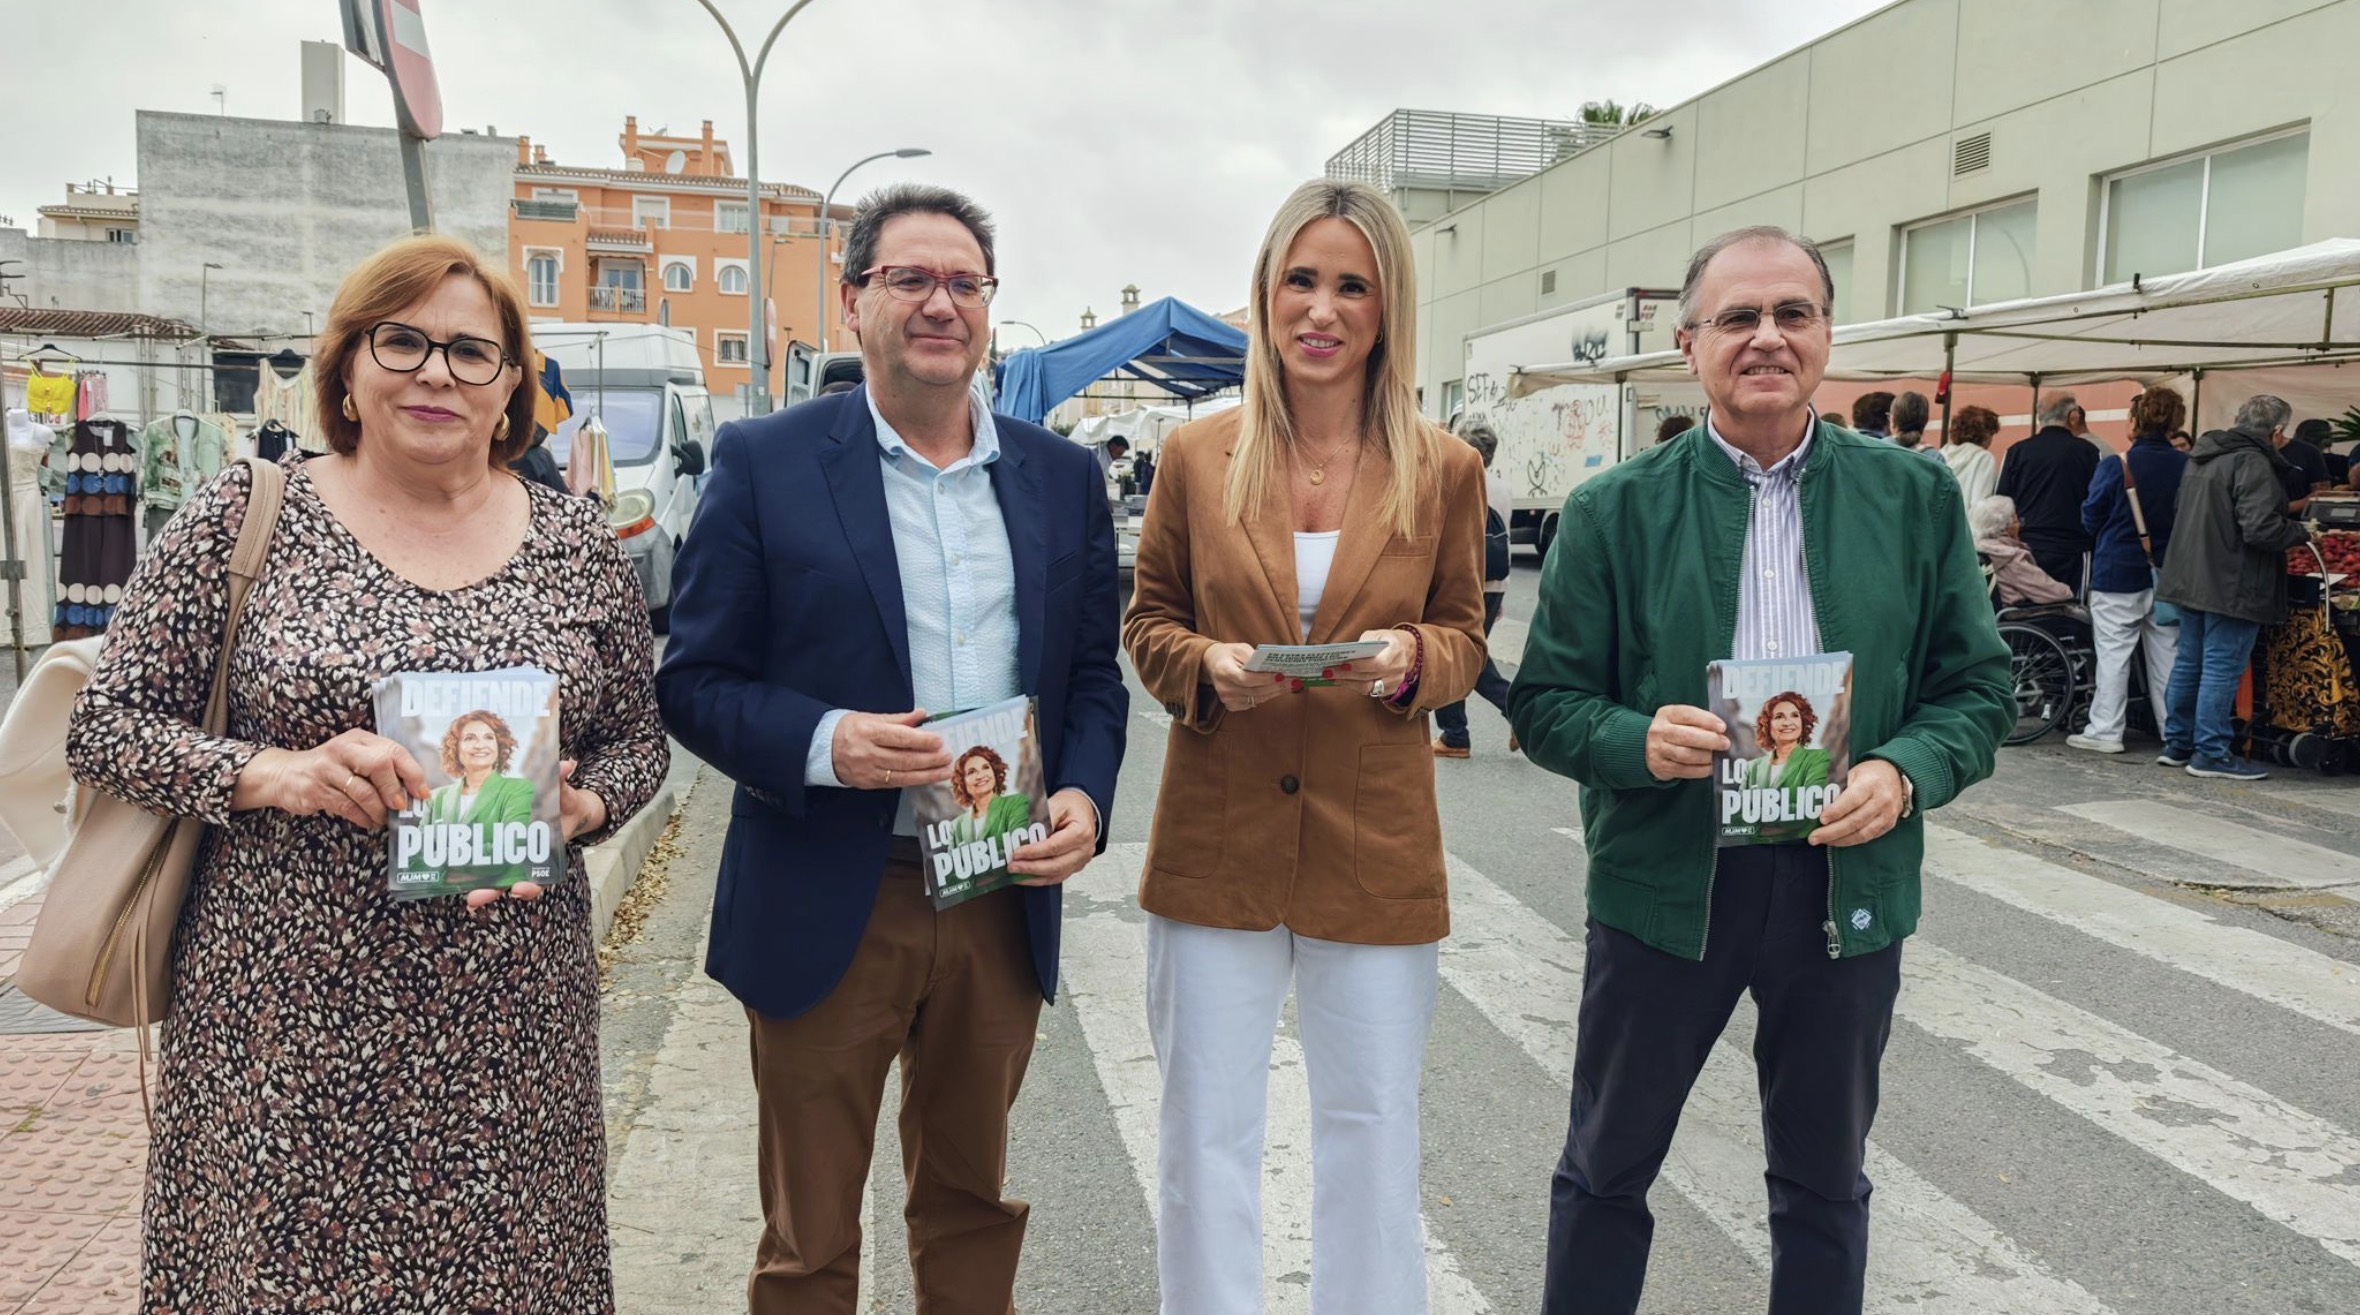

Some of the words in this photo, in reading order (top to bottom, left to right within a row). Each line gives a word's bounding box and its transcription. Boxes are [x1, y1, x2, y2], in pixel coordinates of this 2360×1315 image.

[401, 680, 550, 717] DEFIENDE
[1722, 661, 1846, 699] DEFIENDE
[398, 819, 550, 869] PÚBLICO
